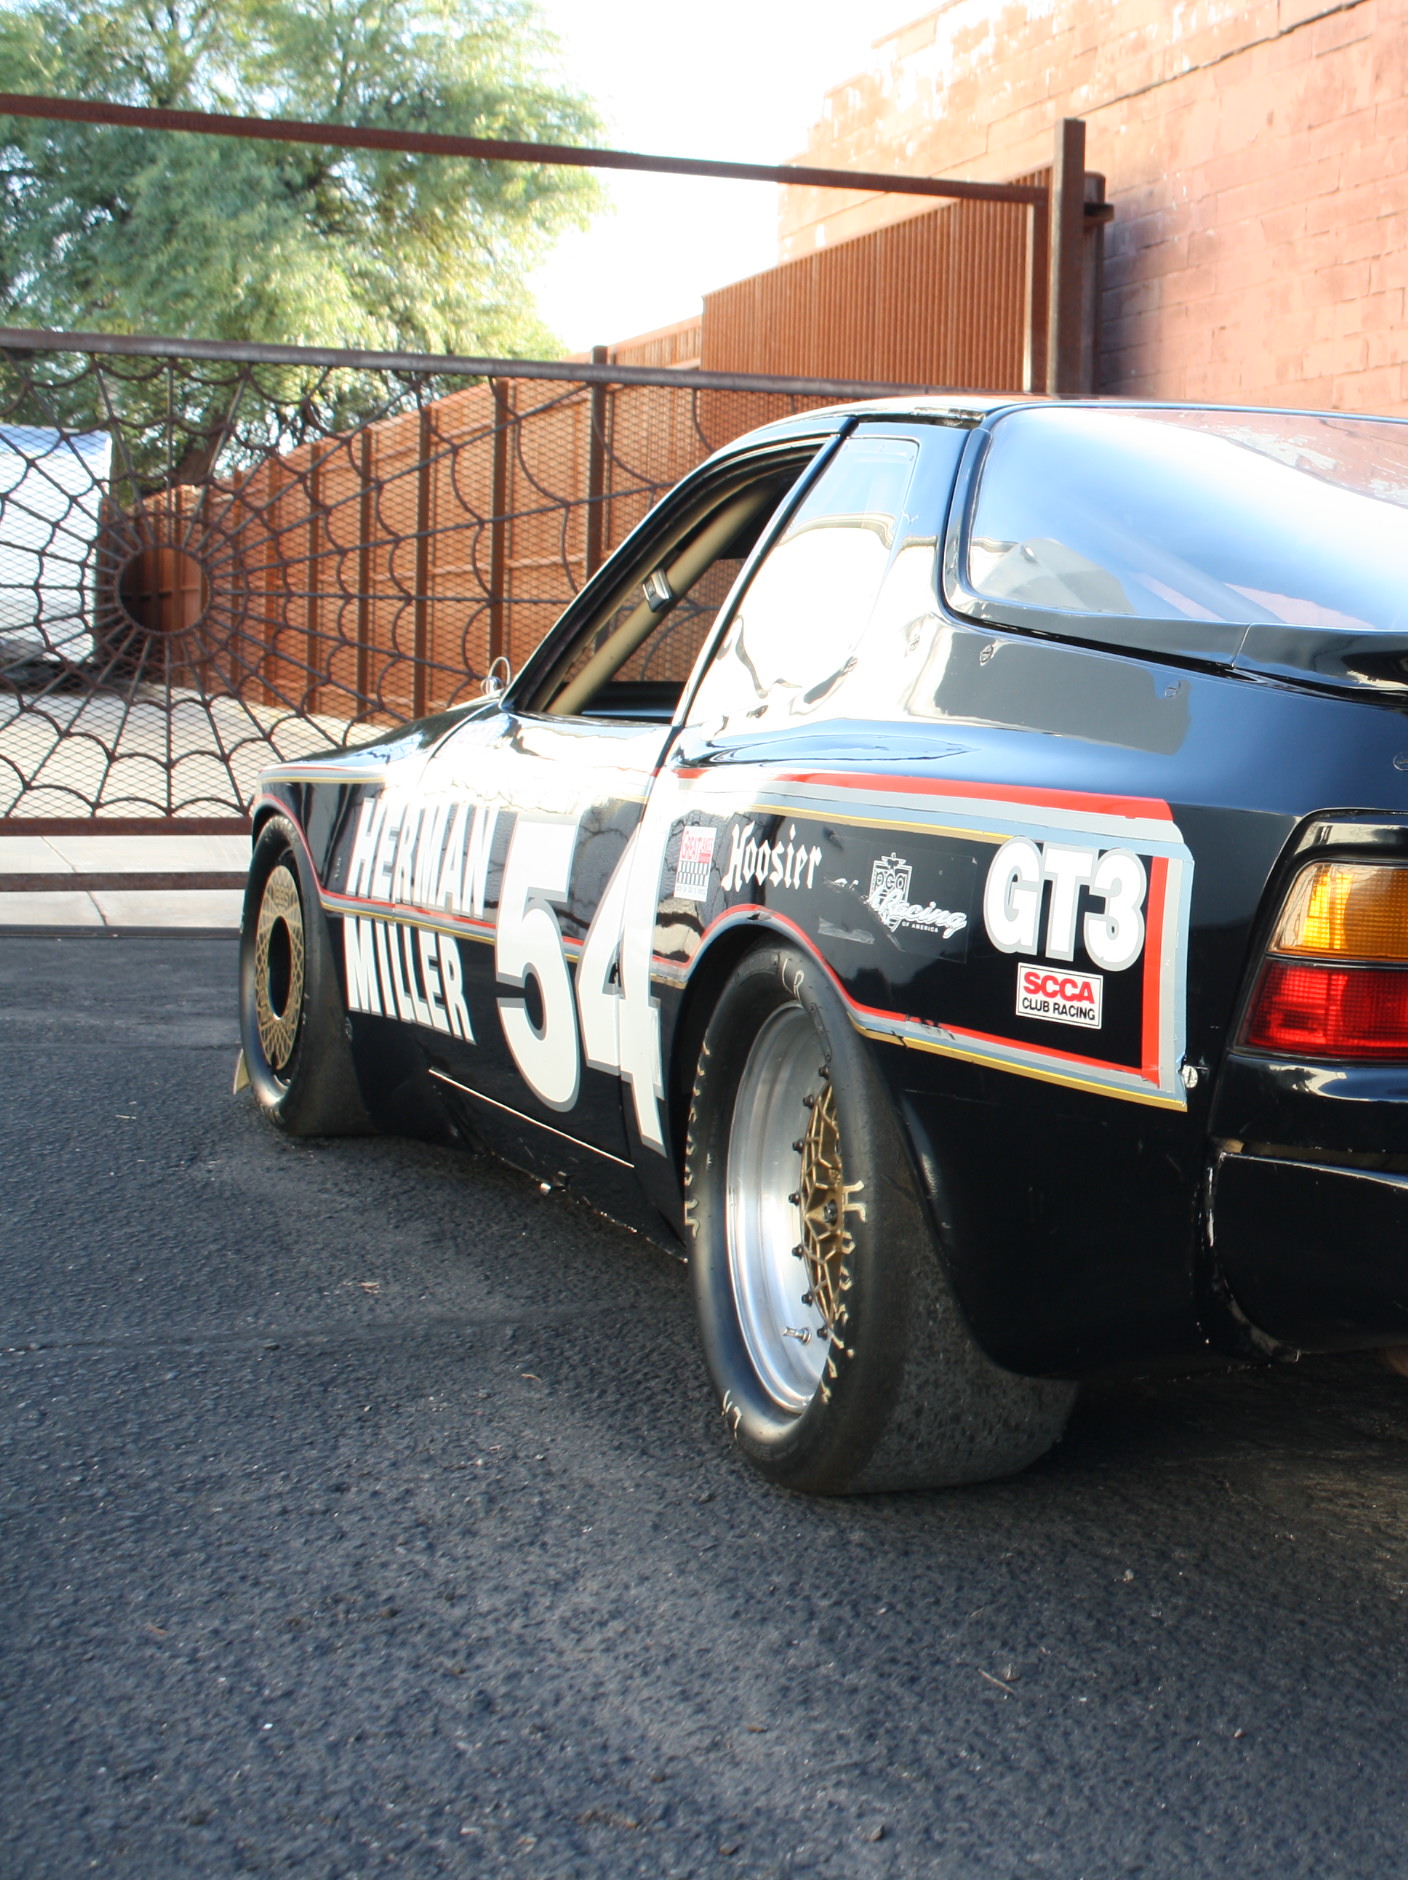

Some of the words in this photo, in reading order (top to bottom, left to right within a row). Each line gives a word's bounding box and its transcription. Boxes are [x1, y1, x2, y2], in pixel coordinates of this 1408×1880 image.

[346, 796, 500, 917] HERMAN
[721, 820, 823, 893] Hoosier
[879, 888, 967, 939] Racing
[912, 922, 939, 933] AMERICA
[984, 835, 1148, 972] GT3
[343, 915, 478, 1046] MILLER
[495, 814, 668, 1158] 54
[1022, 997, 1051, 1014] CLUB
[1053, 1001, 1096, 1021] RACING
[1023, 971, 1095, 1004] SCCA
